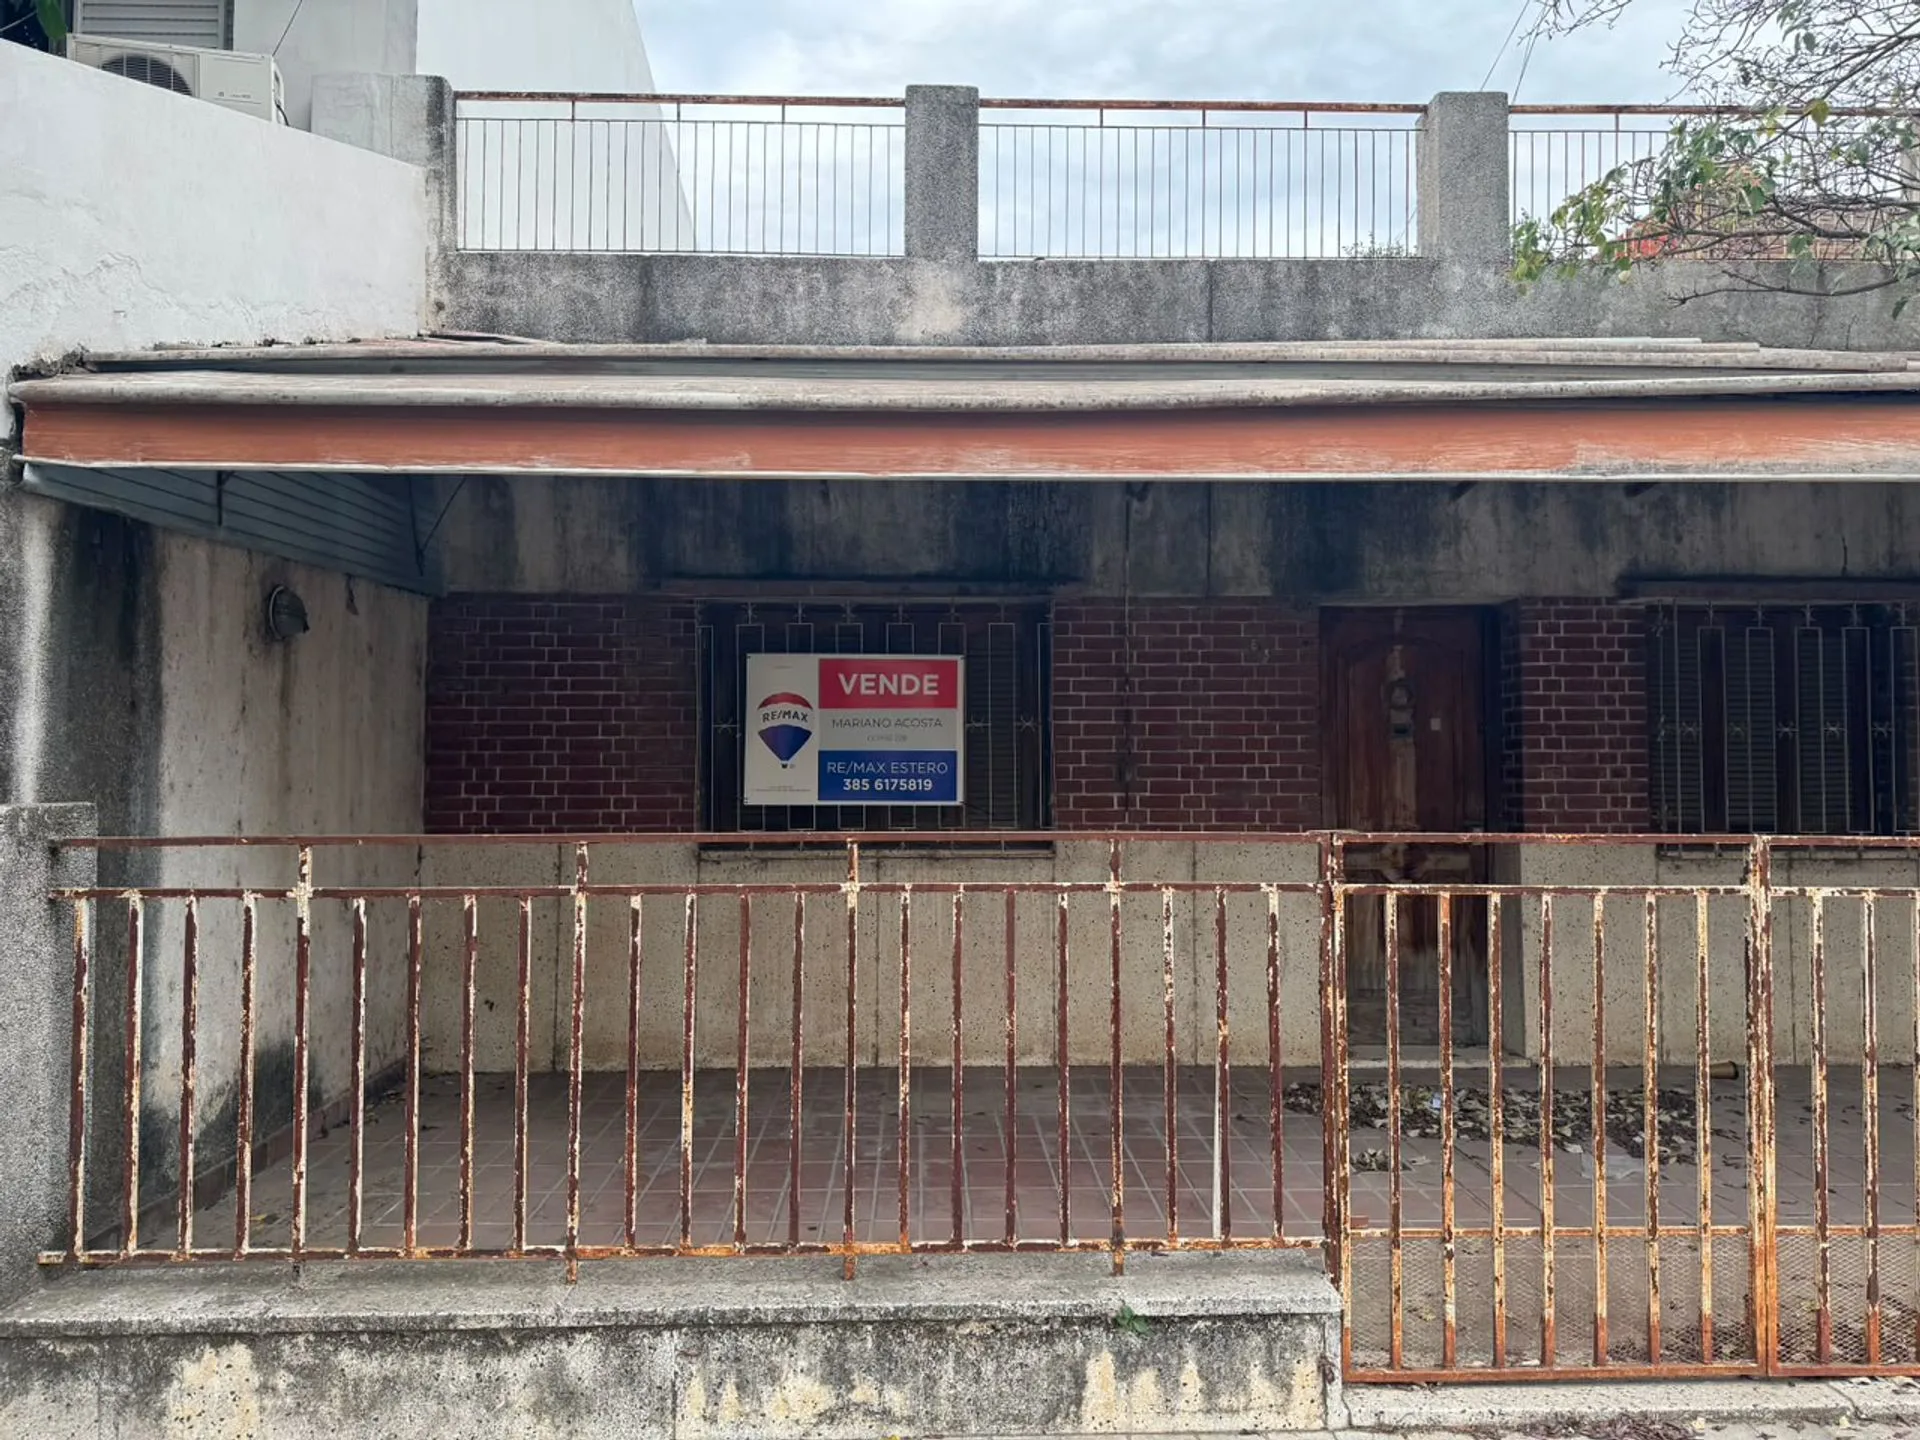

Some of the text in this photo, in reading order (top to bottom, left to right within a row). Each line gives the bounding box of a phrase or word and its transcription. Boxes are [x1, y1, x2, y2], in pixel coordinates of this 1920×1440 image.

[838, 673, 940, 695] VENDE
[762, 709, 809, 723] RE/MAX
[832, 717, 943, 728] MARIANO ACOSTA
[827, 761, 948, 775] RE/MAX ESTERO
[843, 778, 933, 791] 385 6175819
